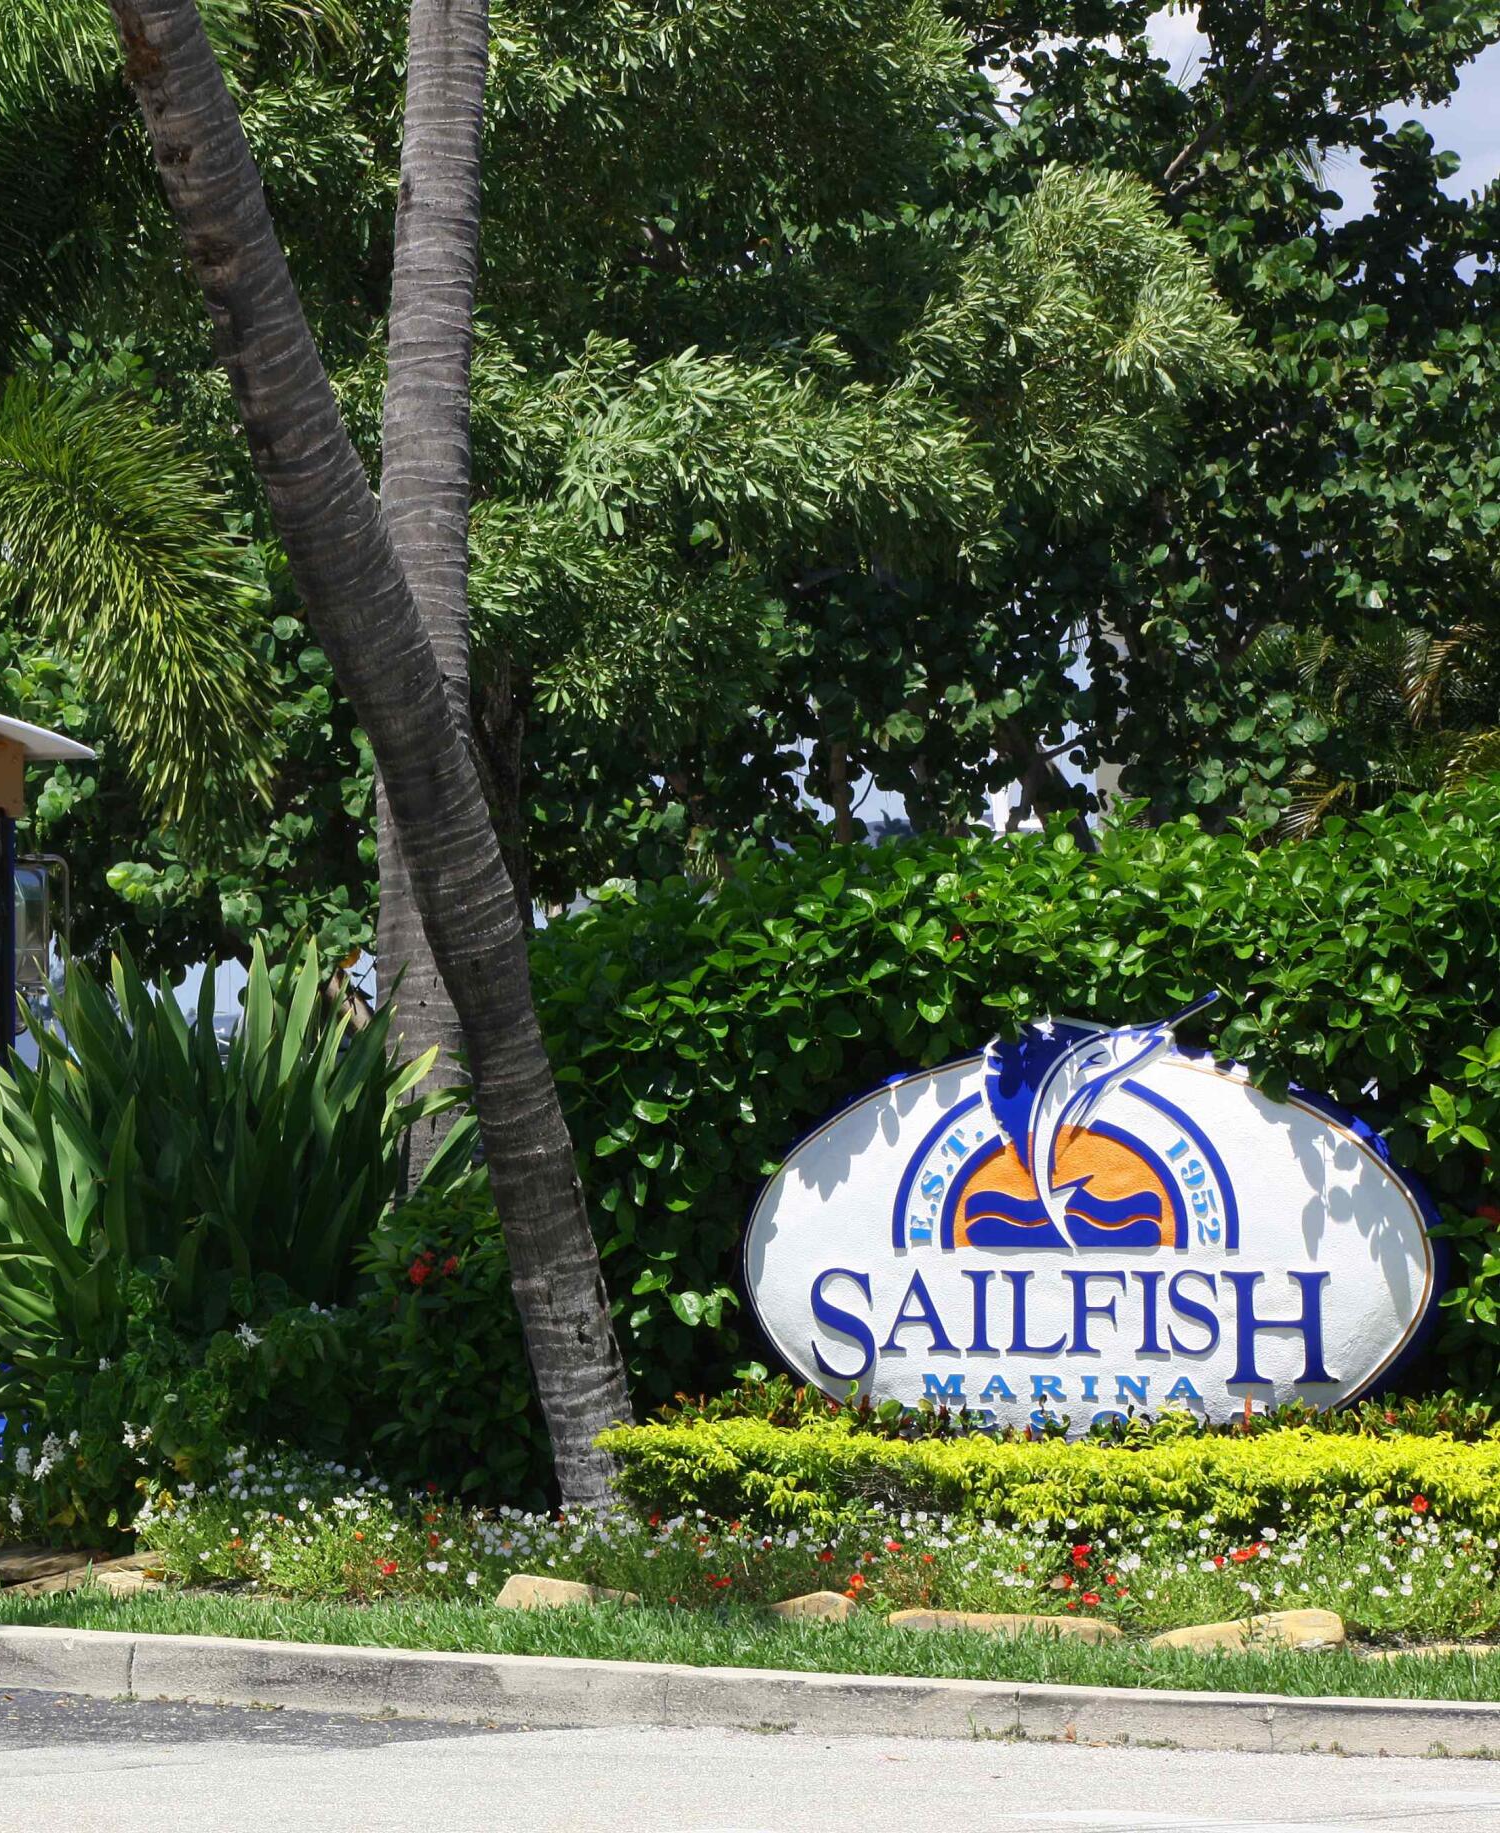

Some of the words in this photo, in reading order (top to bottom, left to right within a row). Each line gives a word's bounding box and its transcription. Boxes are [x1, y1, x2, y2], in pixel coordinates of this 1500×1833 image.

[1164, 1136, 1221, 1246] 1952
[810, 1266, 1340, 1385] SAILFISH
[921, 1373, 1202, 1401] MARINA
